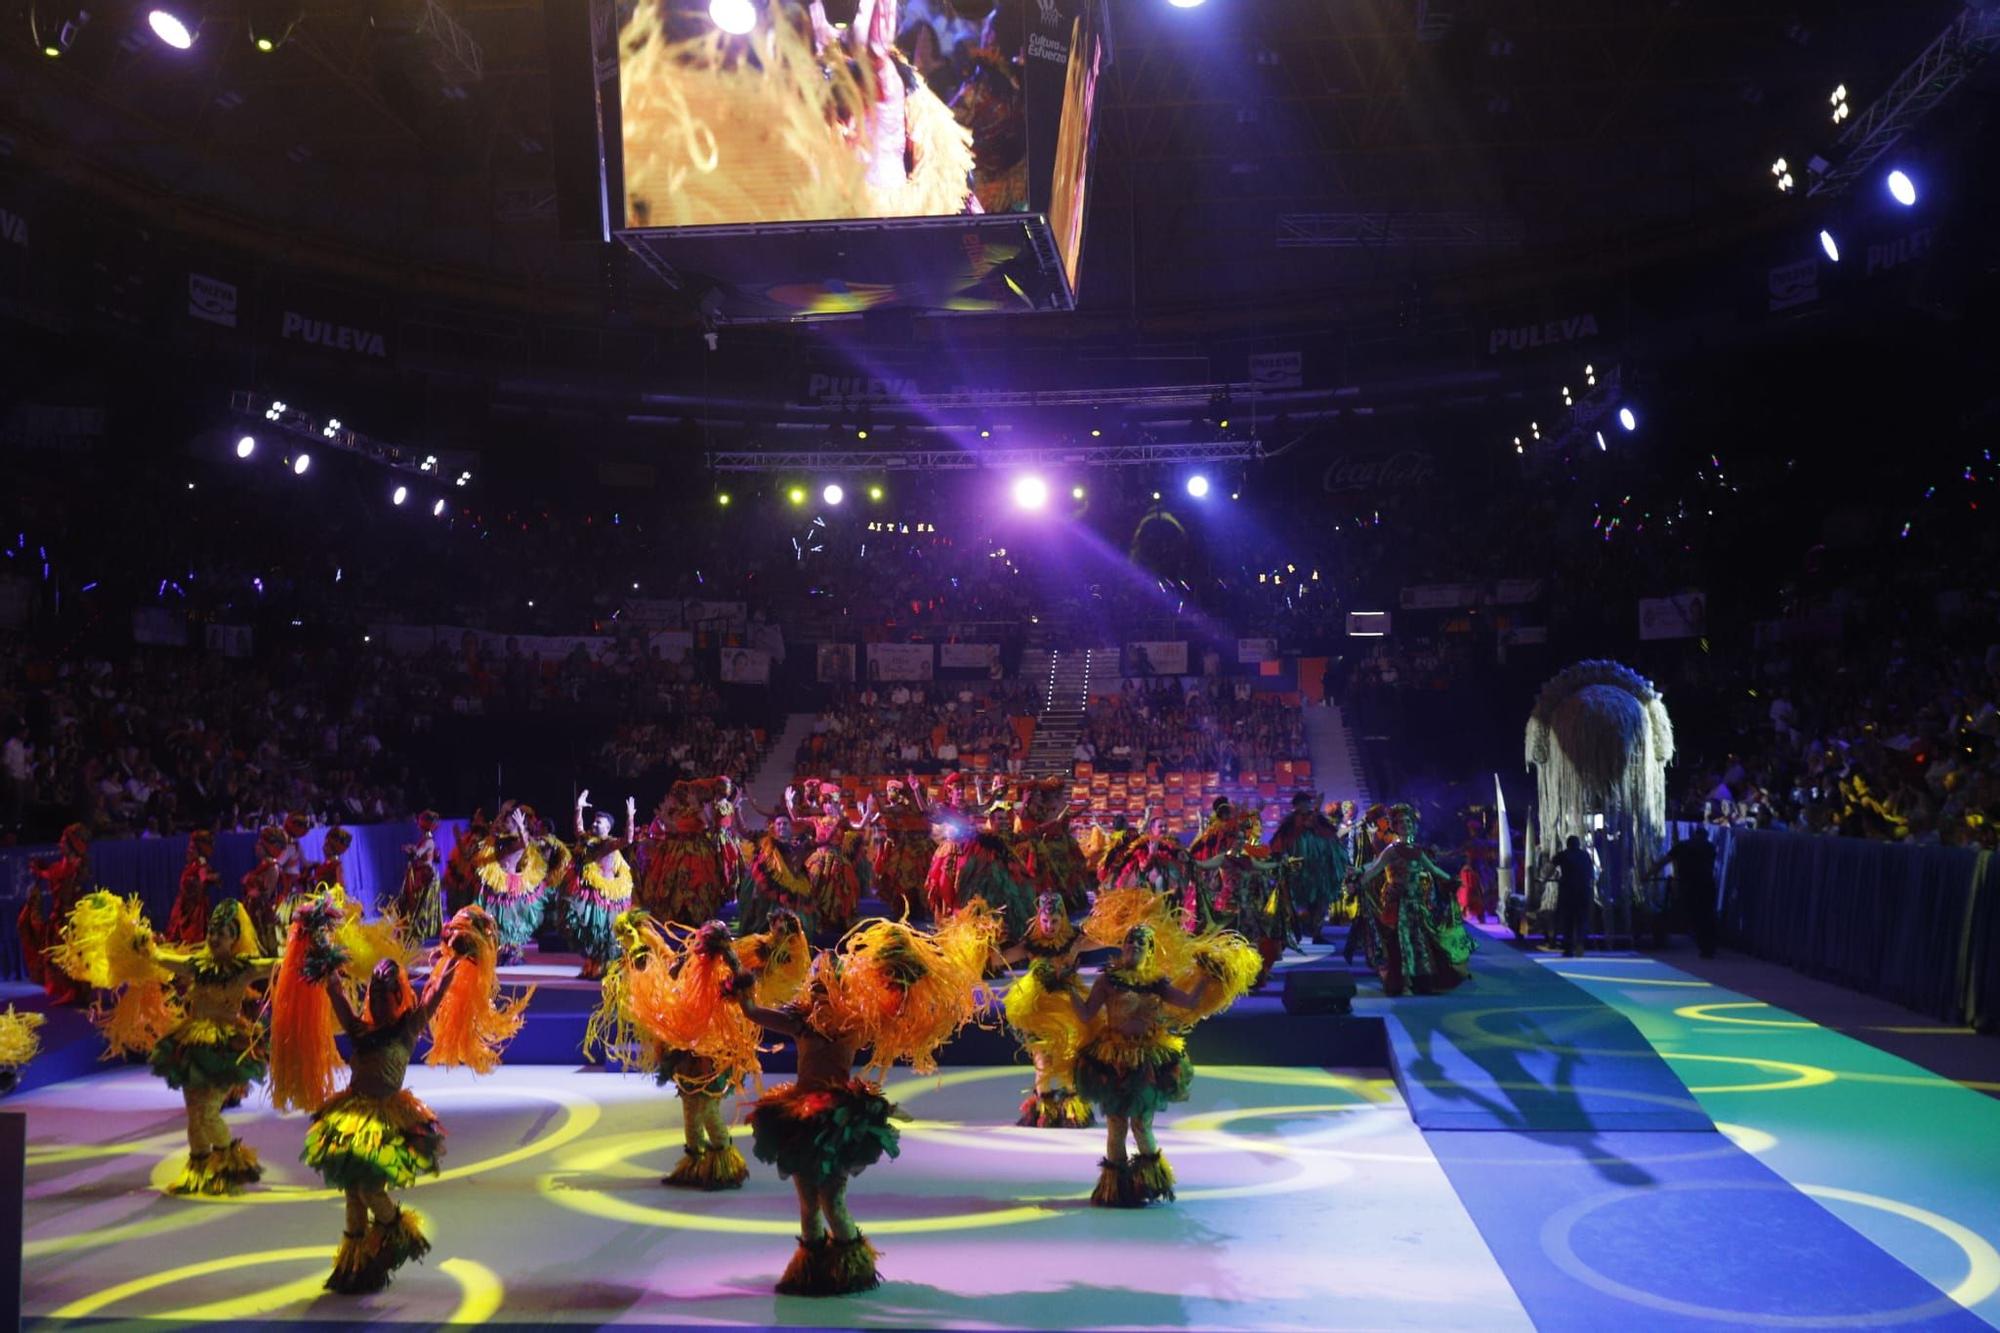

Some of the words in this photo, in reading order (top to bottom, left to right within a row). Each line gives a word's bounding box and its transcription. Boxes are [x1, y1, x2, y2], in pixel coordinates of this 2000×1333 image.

[1028, 44, 1067, 64] Esfuerzo
[1029, 32, 1060, 50] Cultura
[283, 309, 386, 358] PULEVA
[1488, 313, 1599, 355] PULEVA
[809, 372, 919, 400] PULEVA
